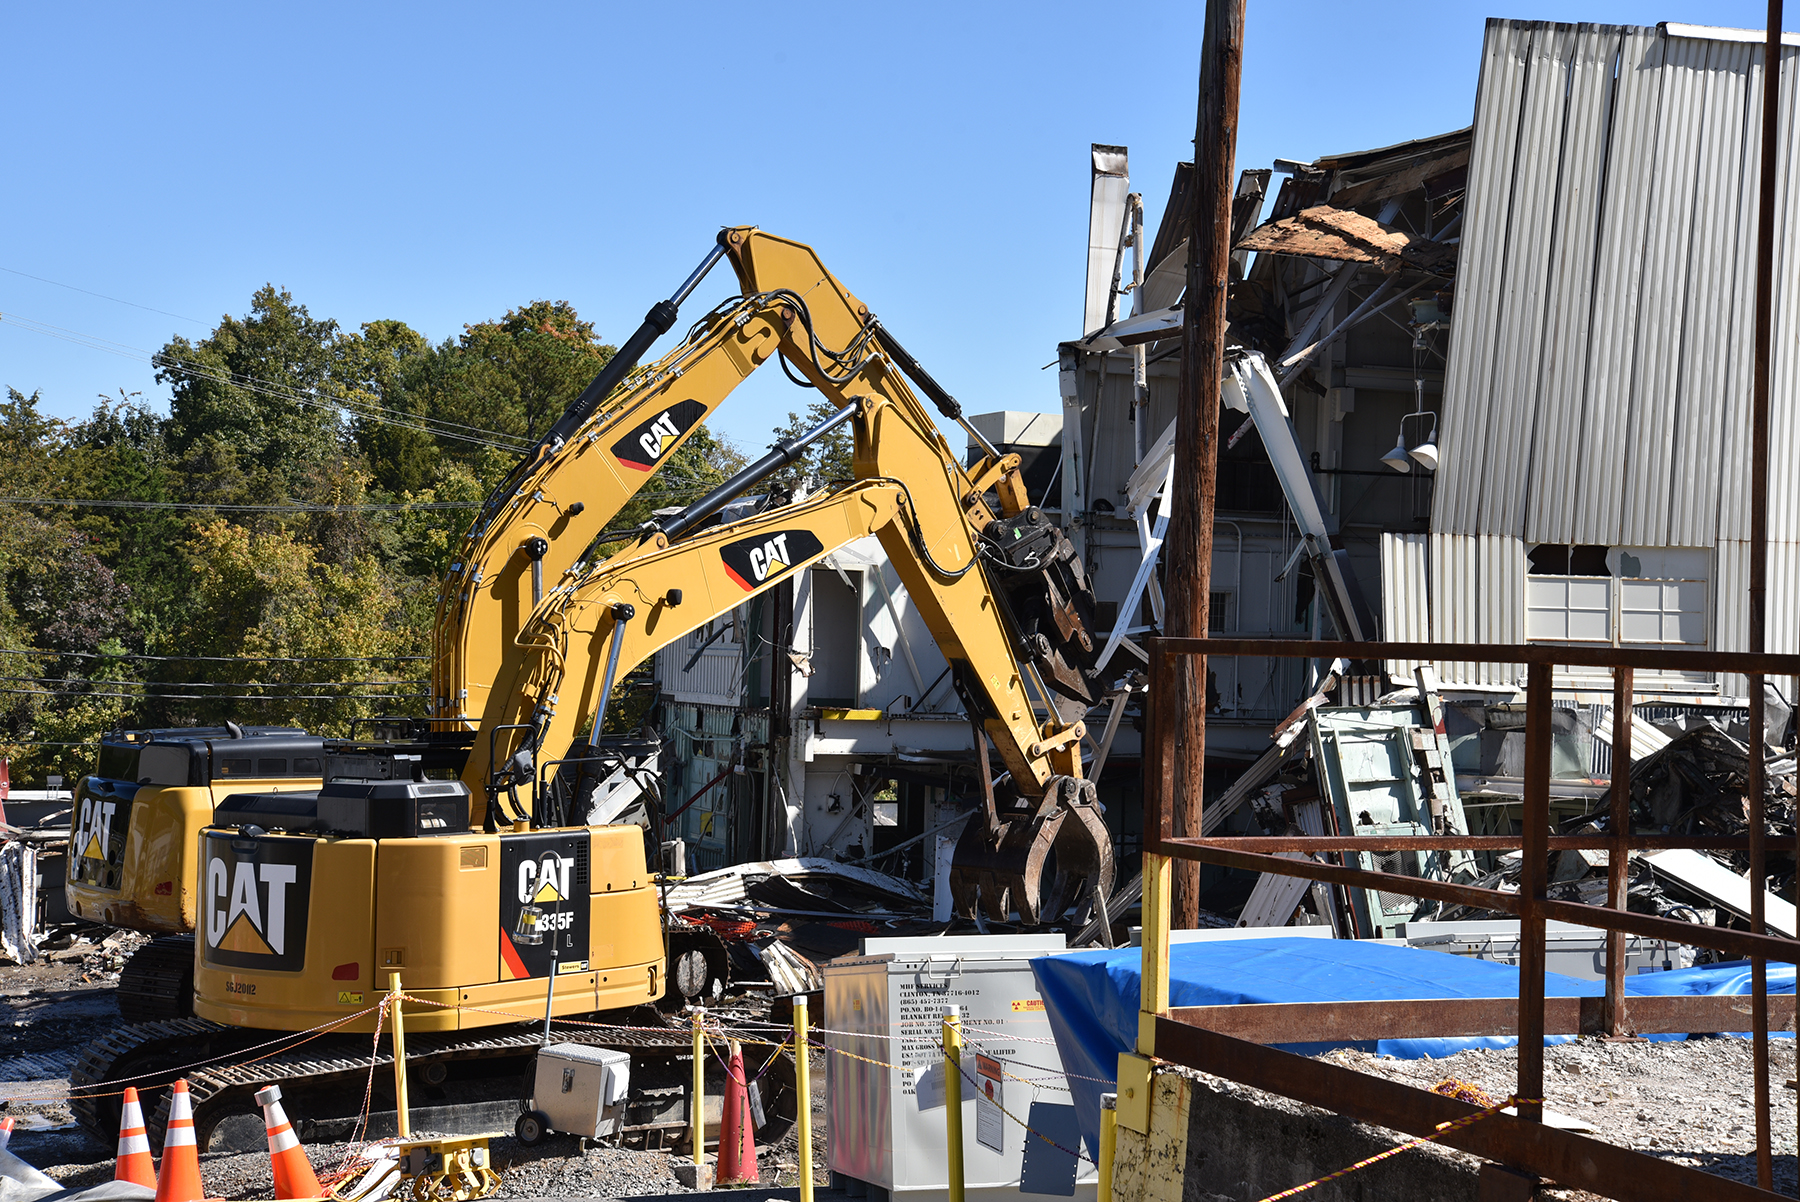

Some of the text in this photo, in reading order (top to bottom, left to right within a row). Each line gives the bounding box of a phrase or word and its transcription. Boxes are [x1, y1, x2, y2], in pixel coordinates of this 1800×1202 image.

[639, 411, 680, 459] CAT
[750, 533, 790, 581] CAT
[78, 797, 116, 860] CAT
[518, 858, 574, 904] CAT
[207, 857, 296, 955] CAT
[542, 911, 574, 931] 335F
